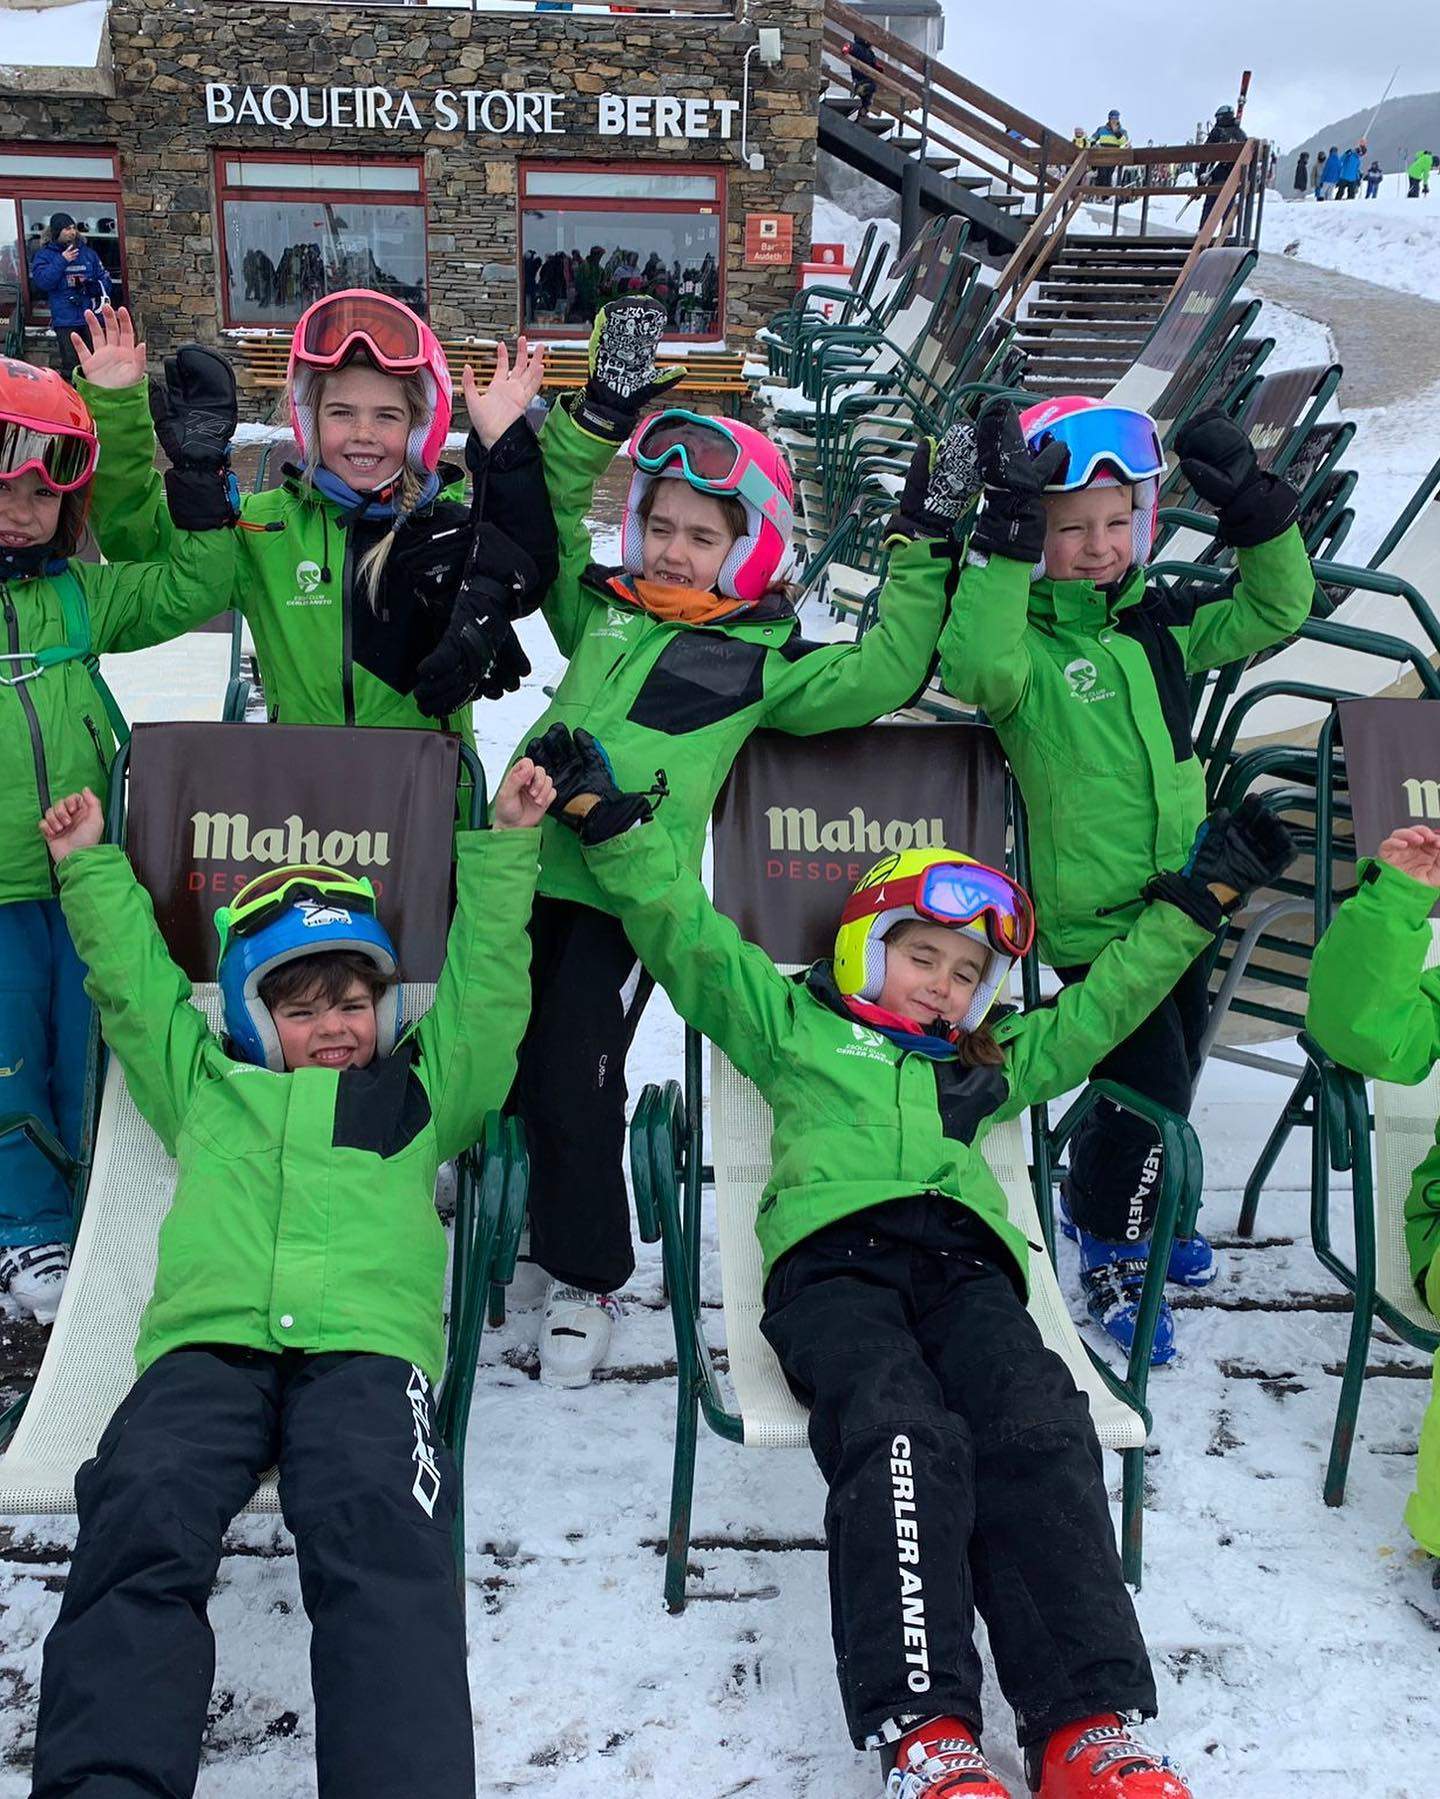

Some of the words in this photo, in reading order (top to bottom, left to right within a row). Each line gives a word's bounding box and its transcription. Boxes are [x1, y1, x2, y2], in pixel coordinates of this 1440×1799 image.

[205, 83, 422, 130] BAQUEIRA
[434, 89, 566, 134] STORE
[598, 93, 739, 138] BERET
[191, 811, 391, 866] Mahou
[765, 806, 947, 853] Mahou
[189, 872, 249, 892] DES
[767, 859, 860, 881] DESDE
